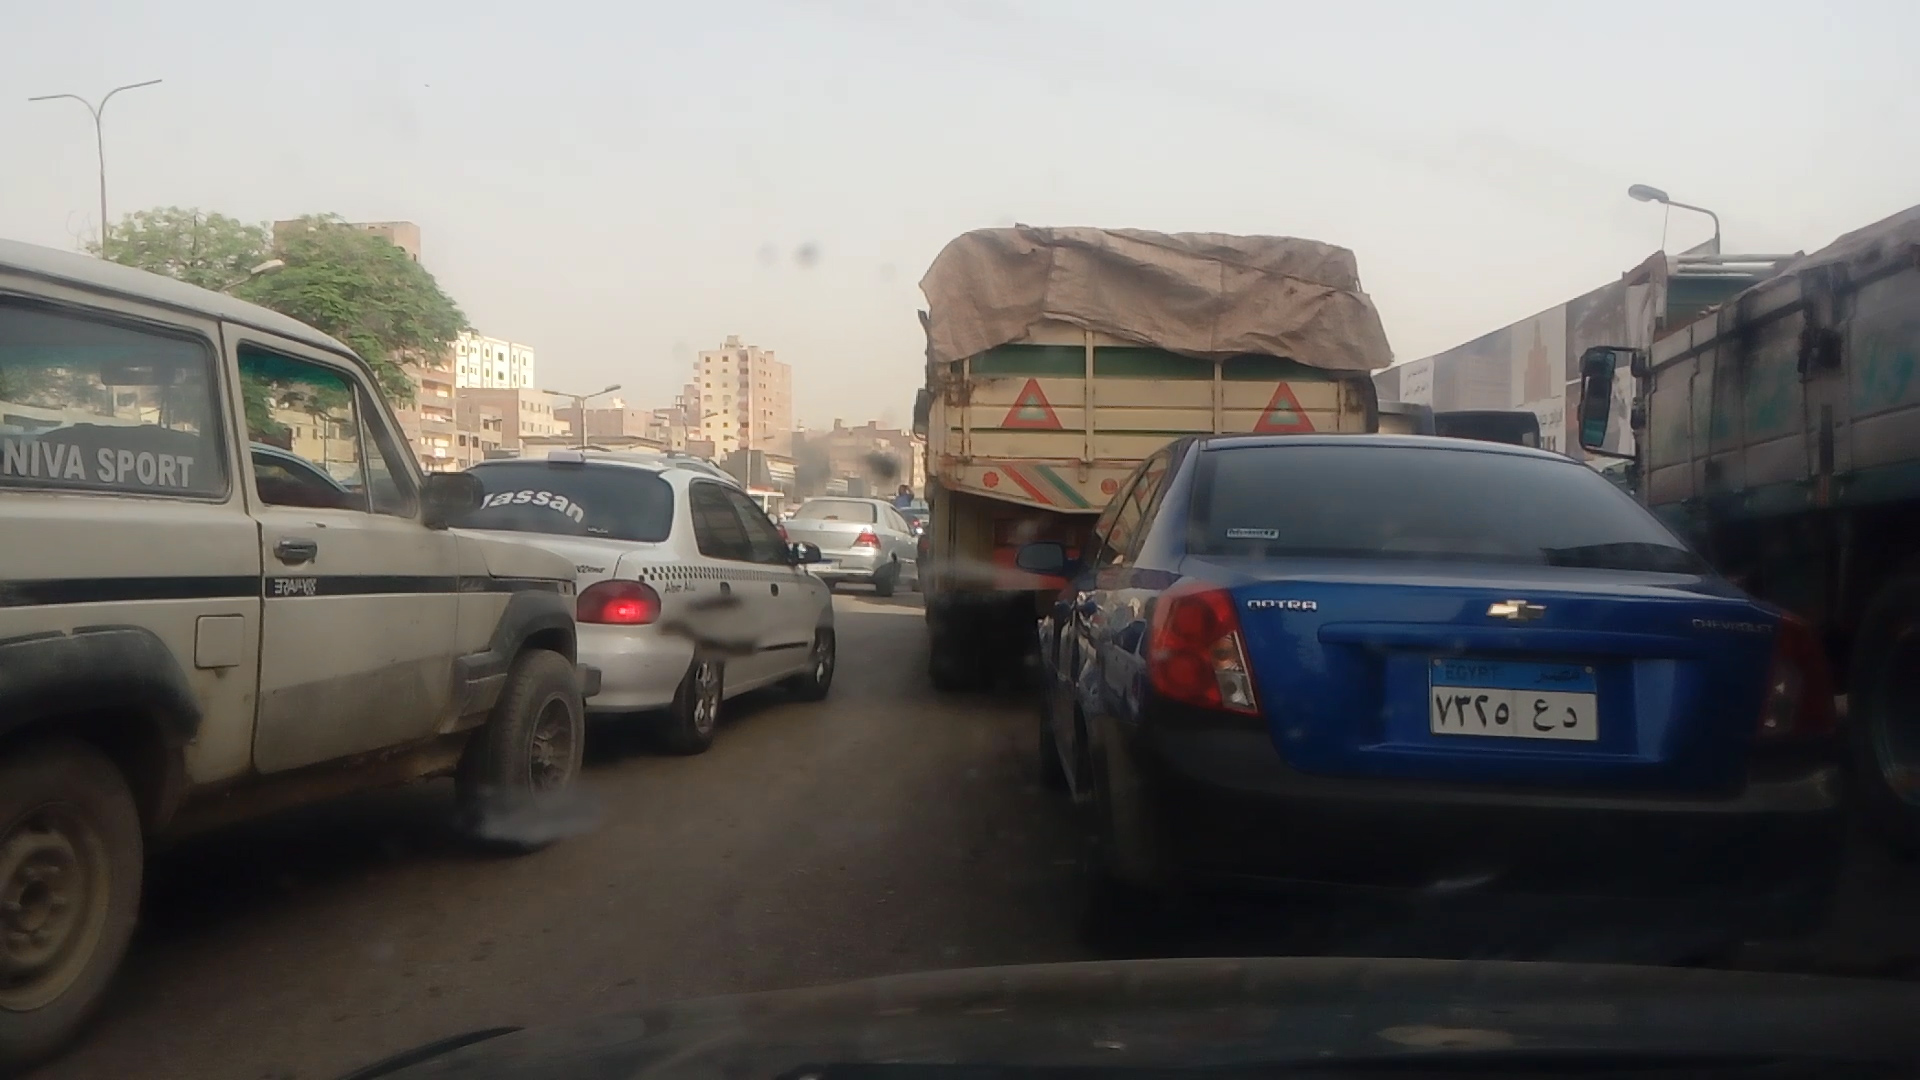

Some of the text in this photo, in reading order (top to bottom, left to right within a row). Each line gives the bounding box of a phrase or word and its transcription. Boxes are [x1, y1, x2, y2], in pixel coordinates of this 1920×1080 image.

[3, 438, 194, 488] NIVA SPORT
[1445, 664, 1500, 681] EGYPT
[1436, 693, 1510, 729] ٧٣٢٥
